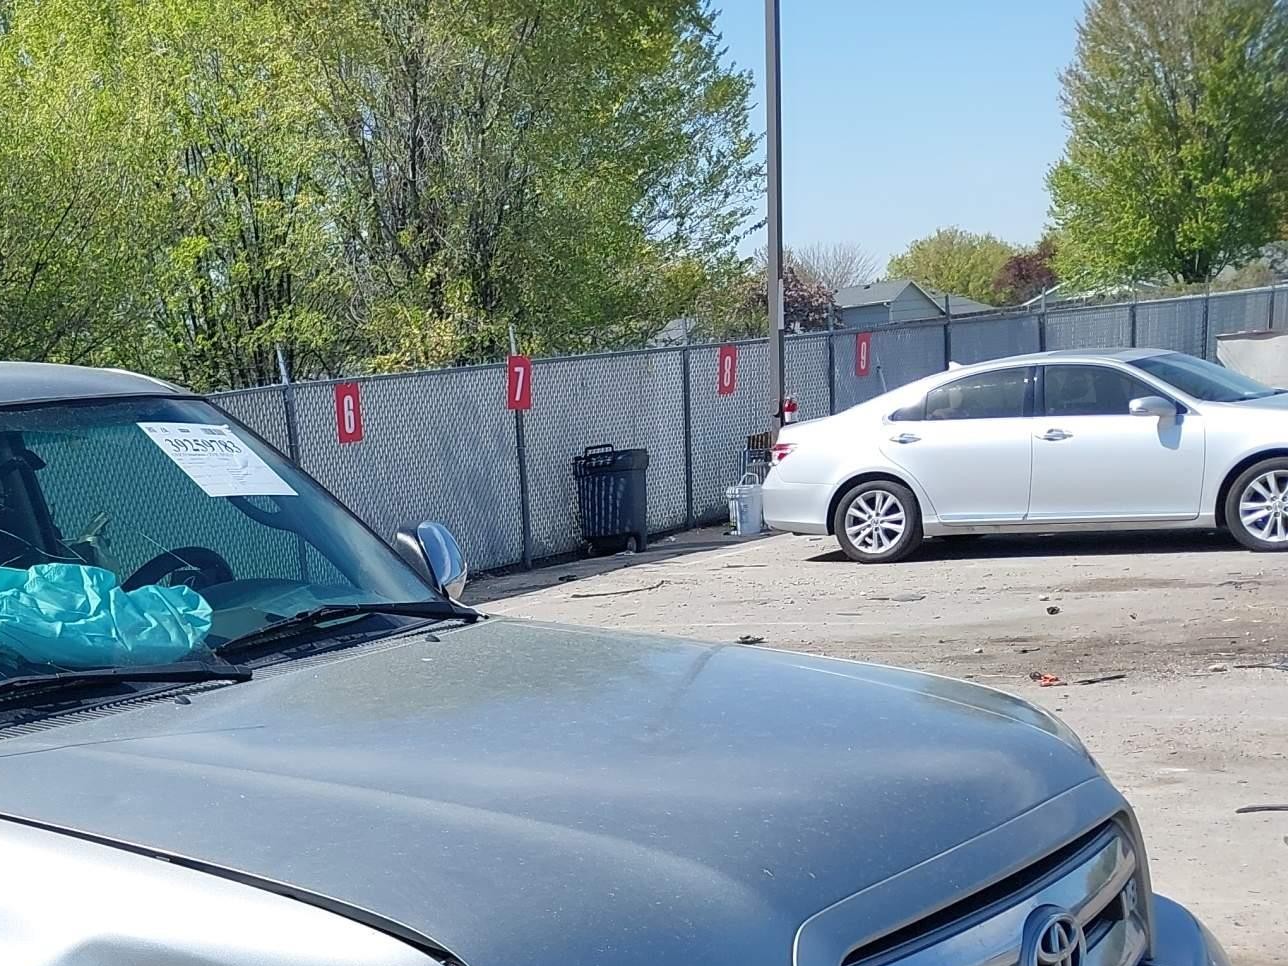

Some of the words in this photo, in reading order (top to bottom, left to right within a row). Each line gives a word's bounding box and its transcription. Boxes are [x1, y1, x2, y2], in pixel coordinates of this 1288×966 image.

[723, 355, 732, 387] 8
[860, 341, 867, 370] 9
[514, 366, 525, 401] 7
[343, 394, 355, 434] 6
[165, 438, 242, 454] 39259783
